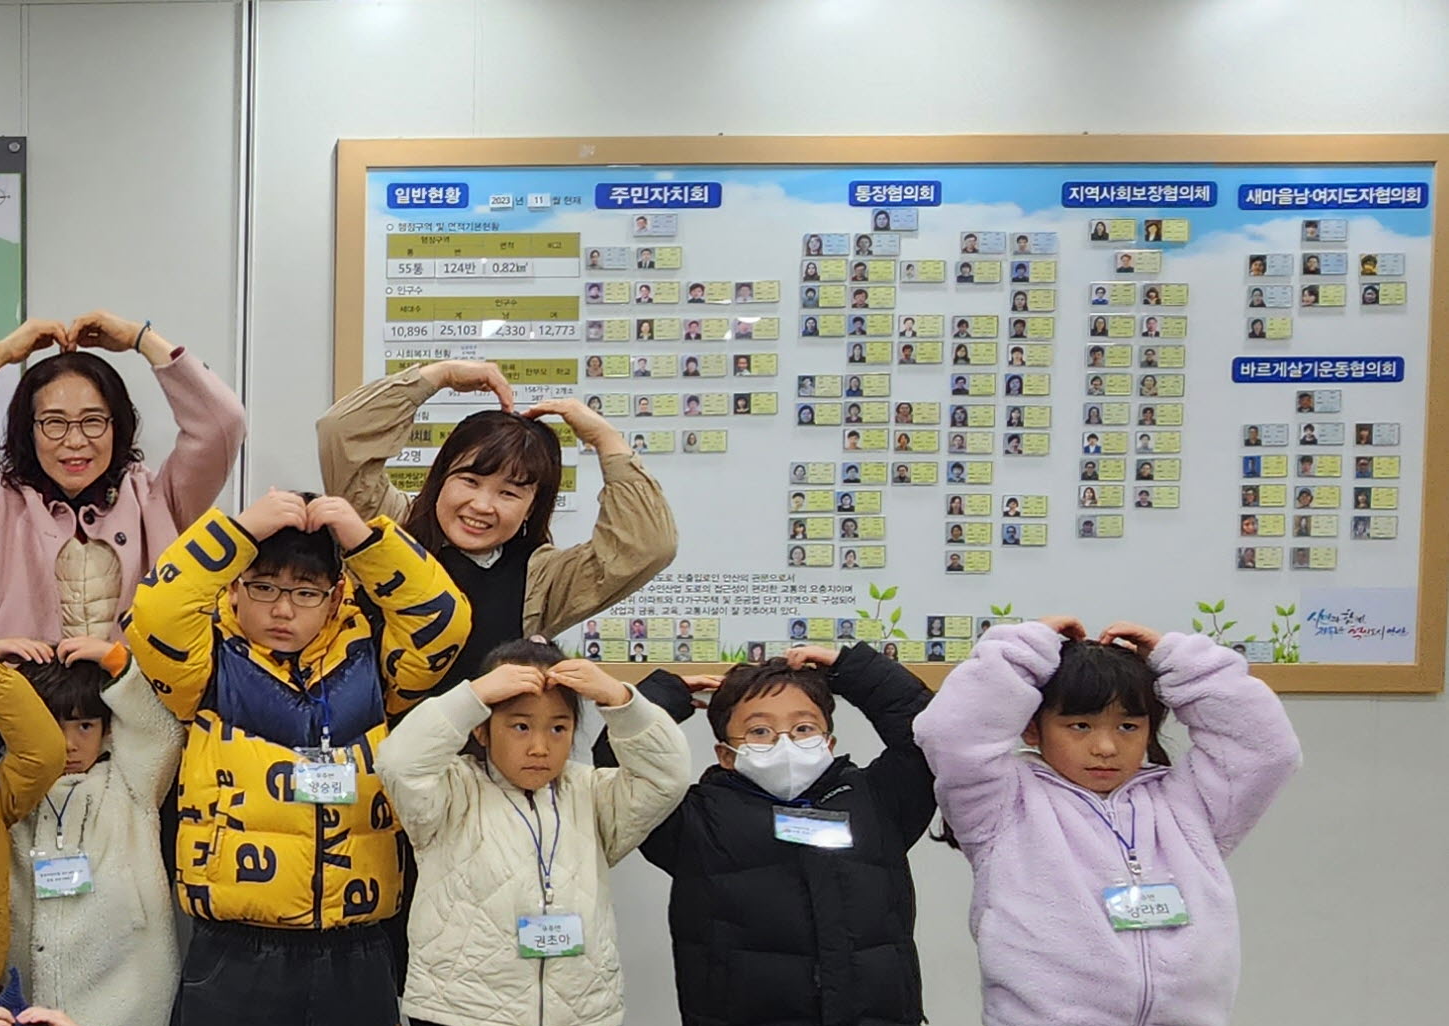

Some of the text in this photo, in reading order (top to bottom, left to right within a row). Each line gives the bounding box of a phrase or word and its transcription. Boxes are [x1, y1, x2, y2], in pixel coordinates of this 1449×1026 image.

[394, 186, 462, 205] 일반현황
[608, 185, 709, 205] 주민자치회
[853, 184, 935, 203] 통장협의회
[1068, 184, 1211, 204] 지역사회보장협의체
[491, 196, 511, 205] 2023
[534, 196, 544, 204] 11
[398, 222, 433, 232] 행정구역
[398, 263, 423, 275] 55통
[443, 263, 476, 275] 124반
[397, 286, 423, 296] 인구수
[391, 326, 428, 338] 10,896
[440, 325, 478, 337] 25,103
[494, 325, 526, 337] 2,330
[539, 325, 575, 337] 12,773
[1239, 359, 1398, 379] 바르게살기운동협의회
[533, 933, 571, 949] 권초아
